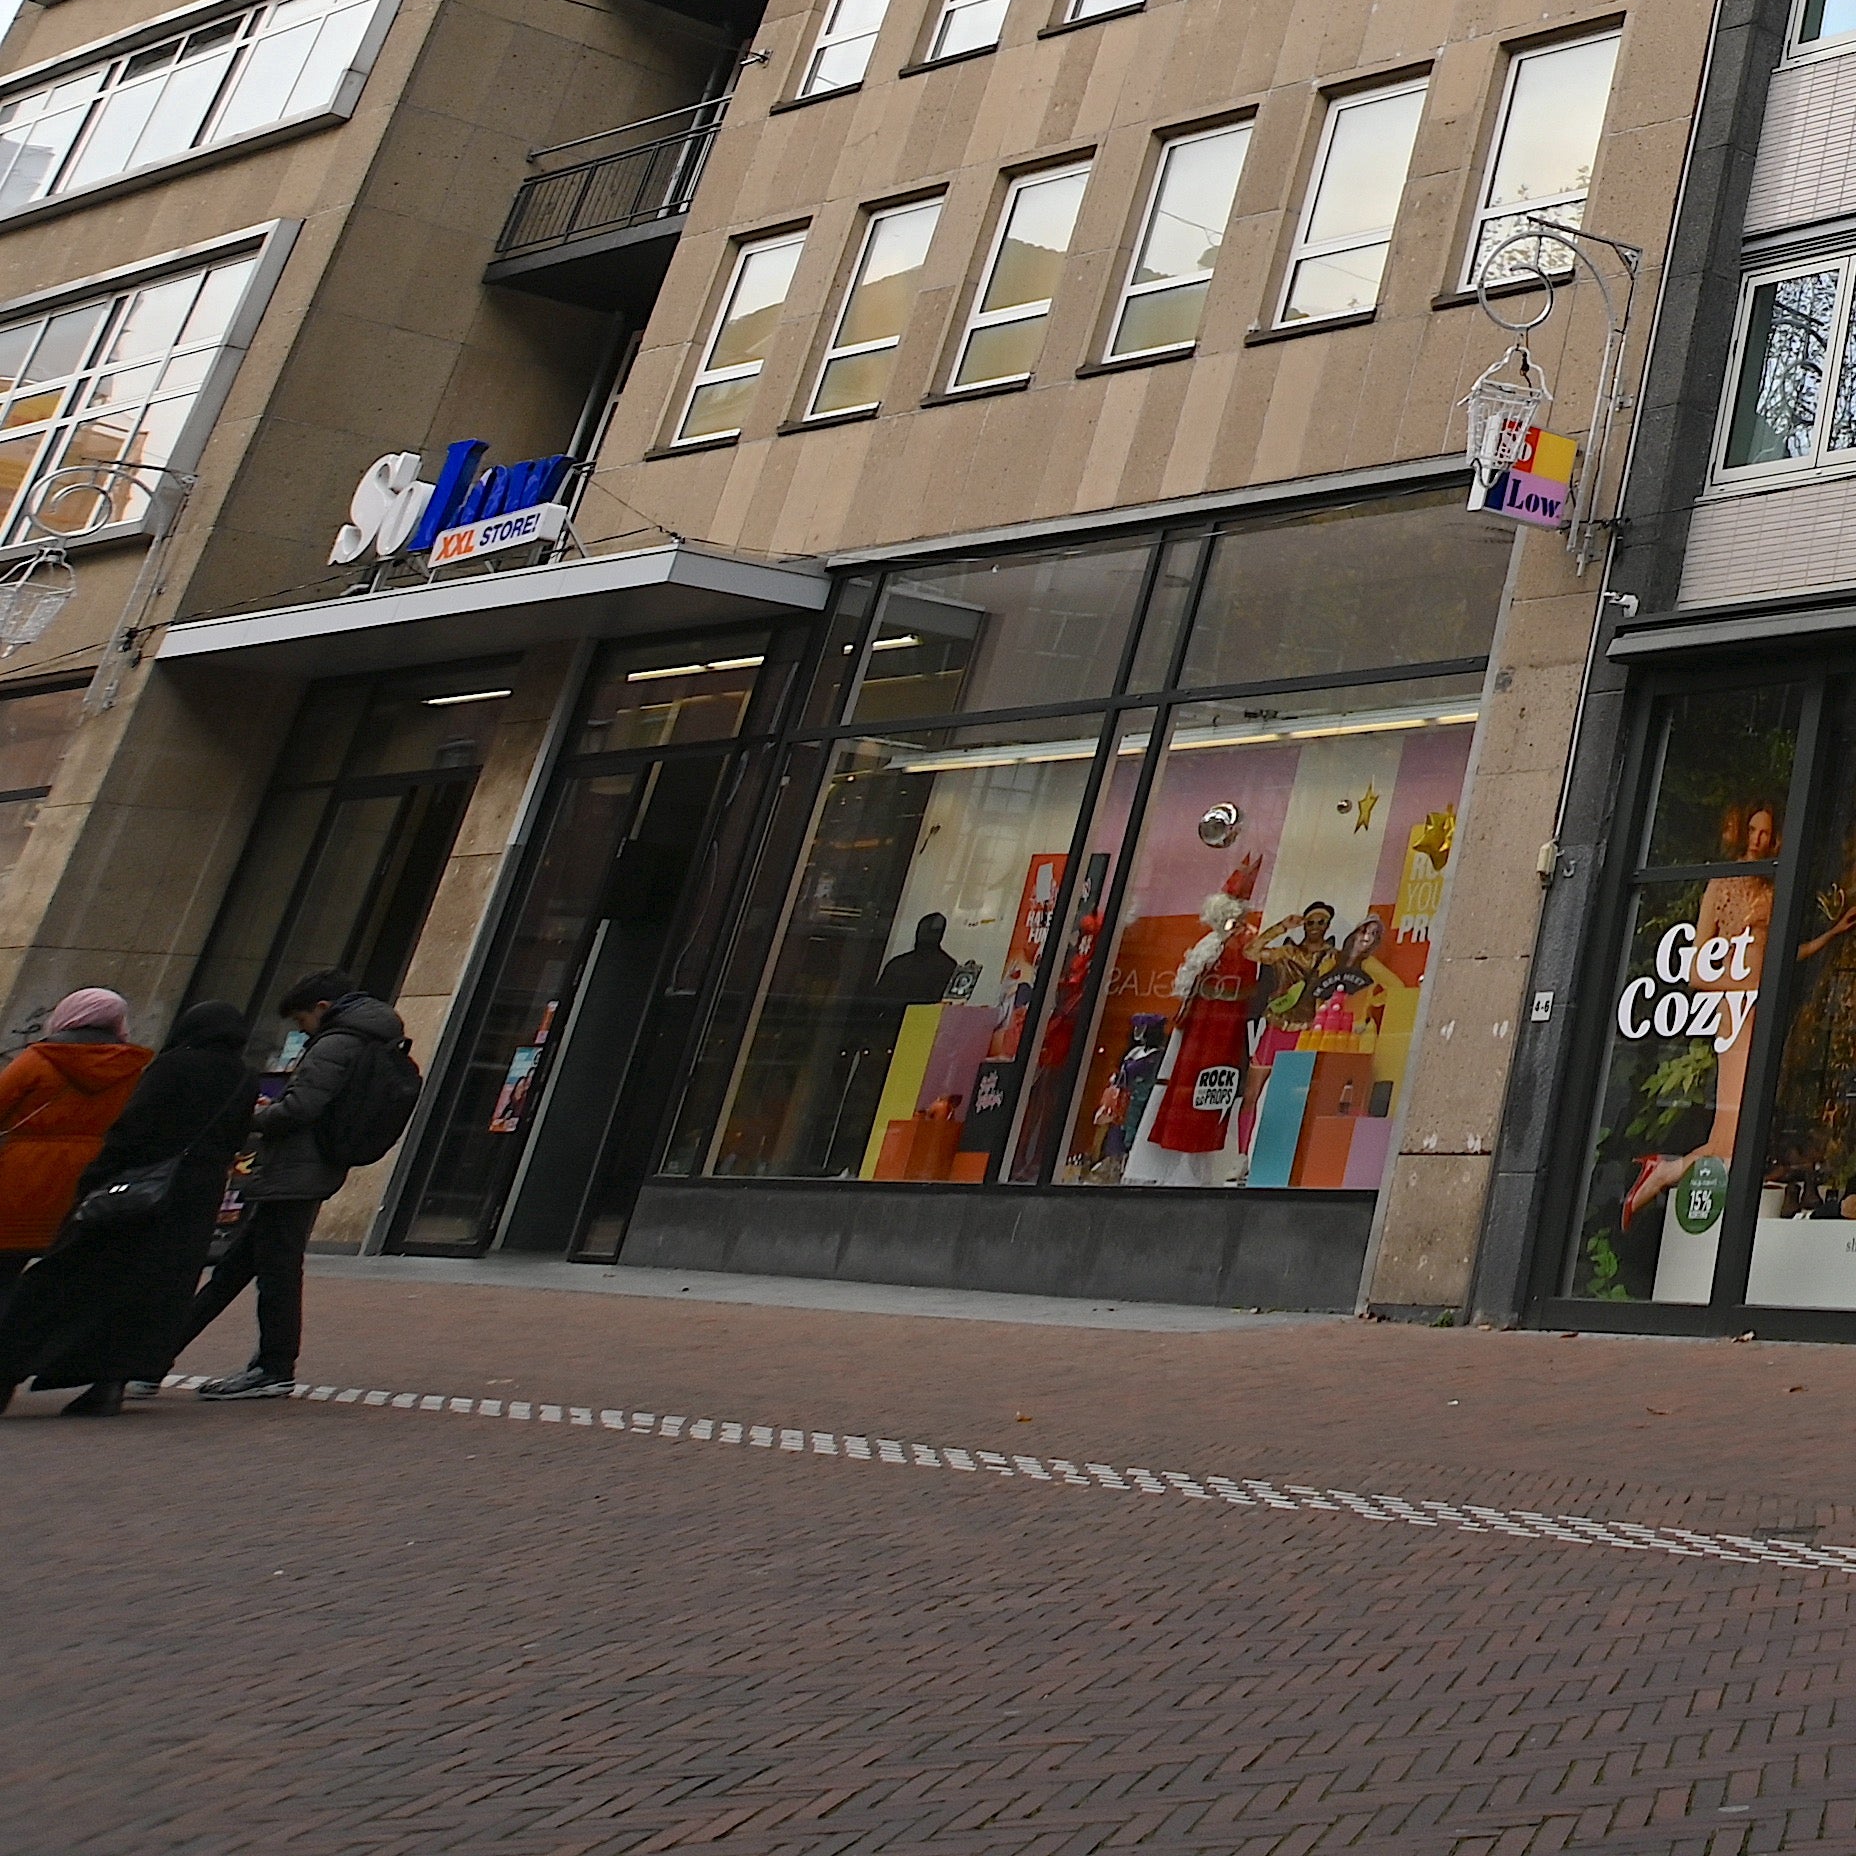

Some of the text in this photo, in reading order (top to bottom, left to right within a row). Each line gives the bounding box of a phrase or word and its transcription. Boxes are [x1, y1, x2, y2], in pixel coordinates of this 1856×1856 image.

[435, 512, 541, 561] XXL STORE!
[1656, 922, 1755, 984] Get
[1617, 976, 1759, 1054] Cozy
[1199, 1069, 1236, 1087] ROCK
[1689, 1190, 1713, 1211] 15%
